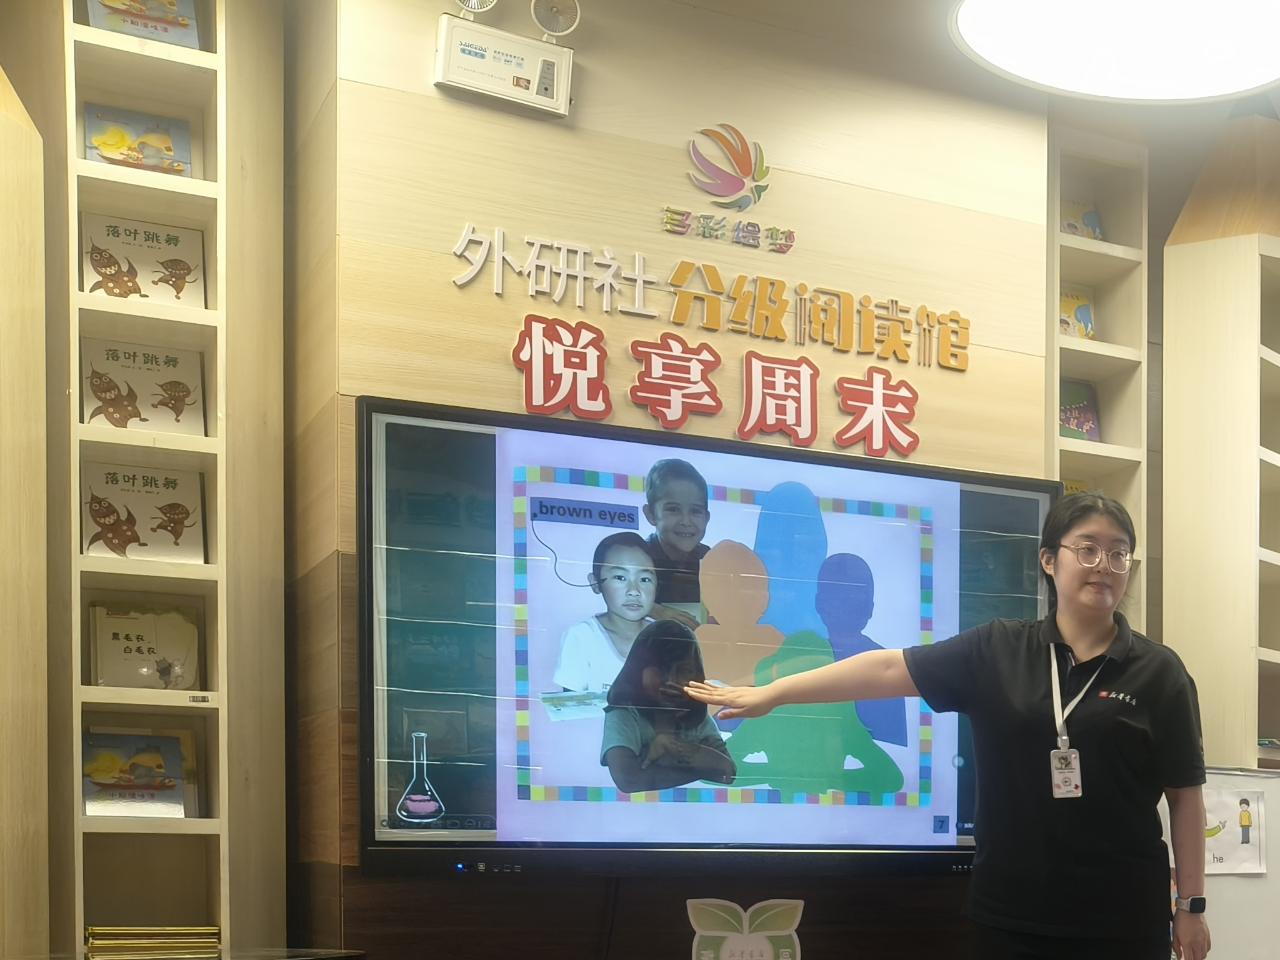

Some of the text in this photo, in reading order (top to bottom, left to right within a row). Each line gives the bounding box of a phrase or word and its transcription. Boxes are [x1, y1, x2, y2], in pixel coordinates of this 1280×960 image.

[512, 314, 919, 457] 悦享周末
[539, 501, 635, 524] brown eyes
[938, 820, 945, 830] 7
[1212, 853, 1224, 864] he
